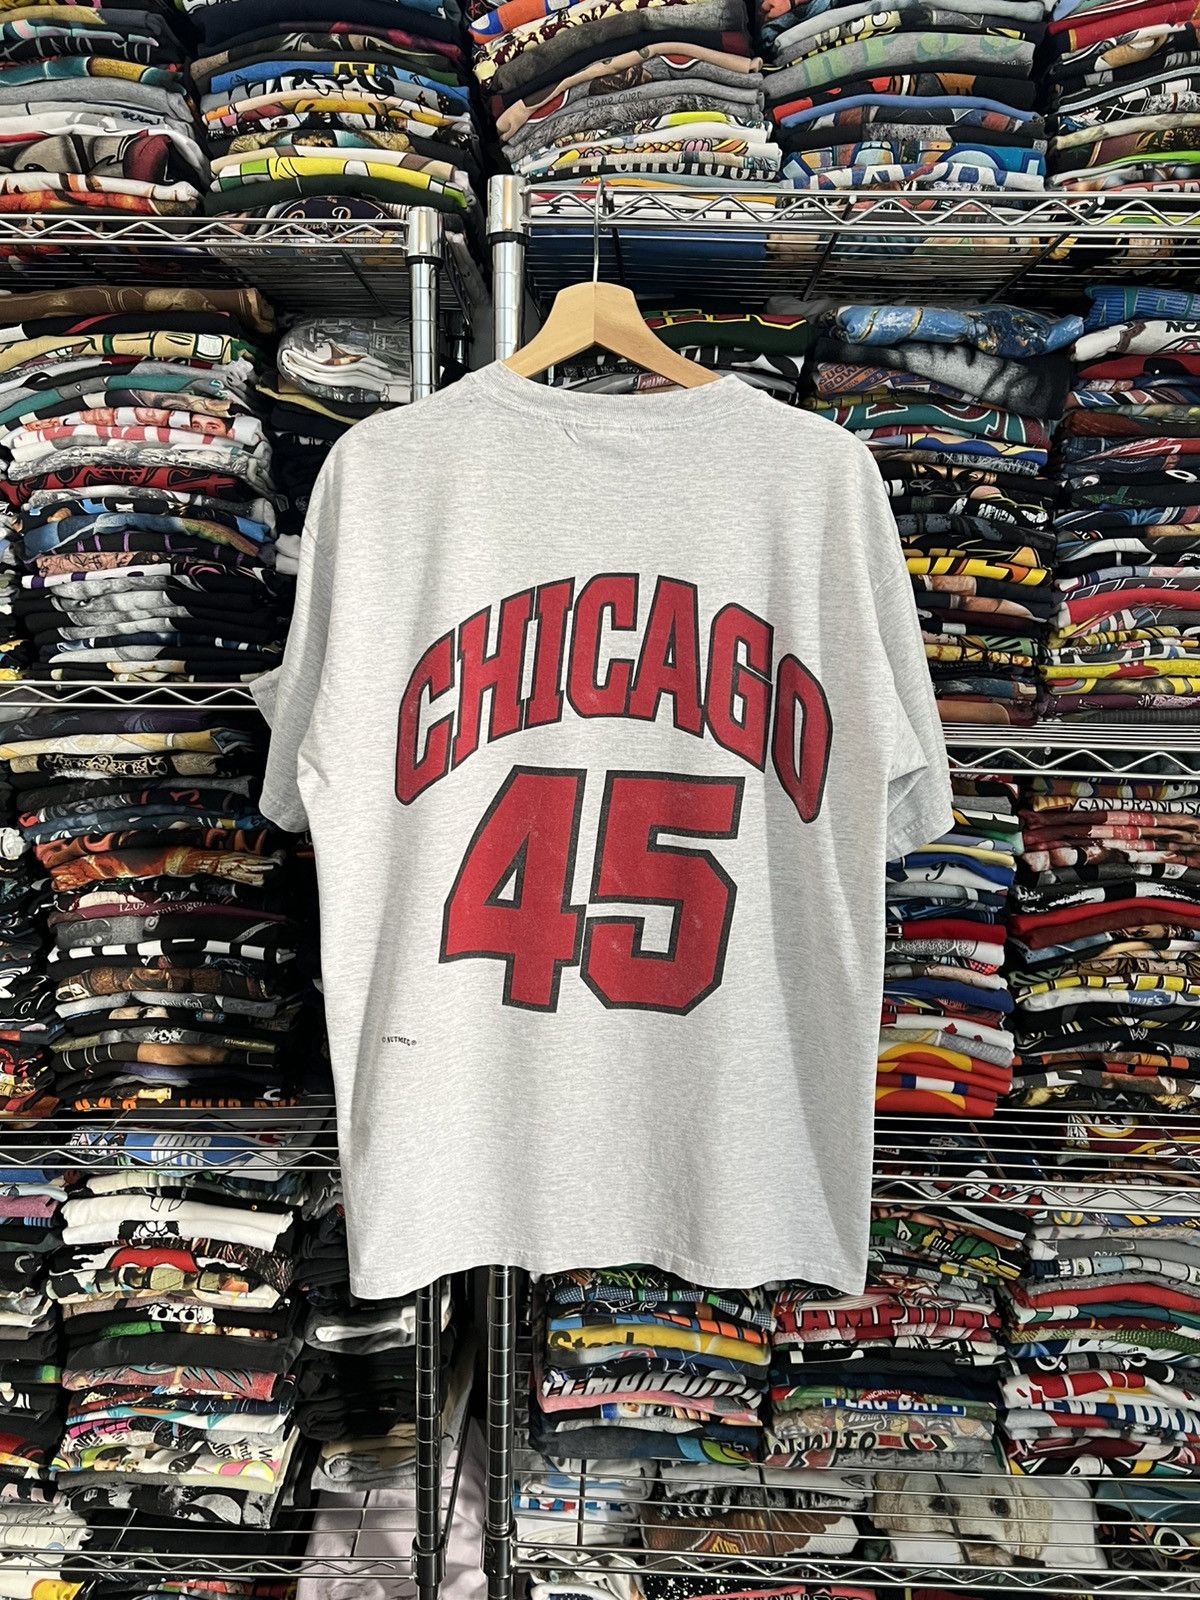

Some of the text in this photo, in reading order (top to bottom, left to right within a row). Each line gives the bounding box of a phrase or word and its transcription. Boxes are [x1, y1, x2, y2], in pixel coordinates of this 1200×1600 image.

[395, 572, 833, 824] CHICAGO
[1079, 798, 1200, 816] SAN FRANCIS
[438, 765, 746, 1016] 45
